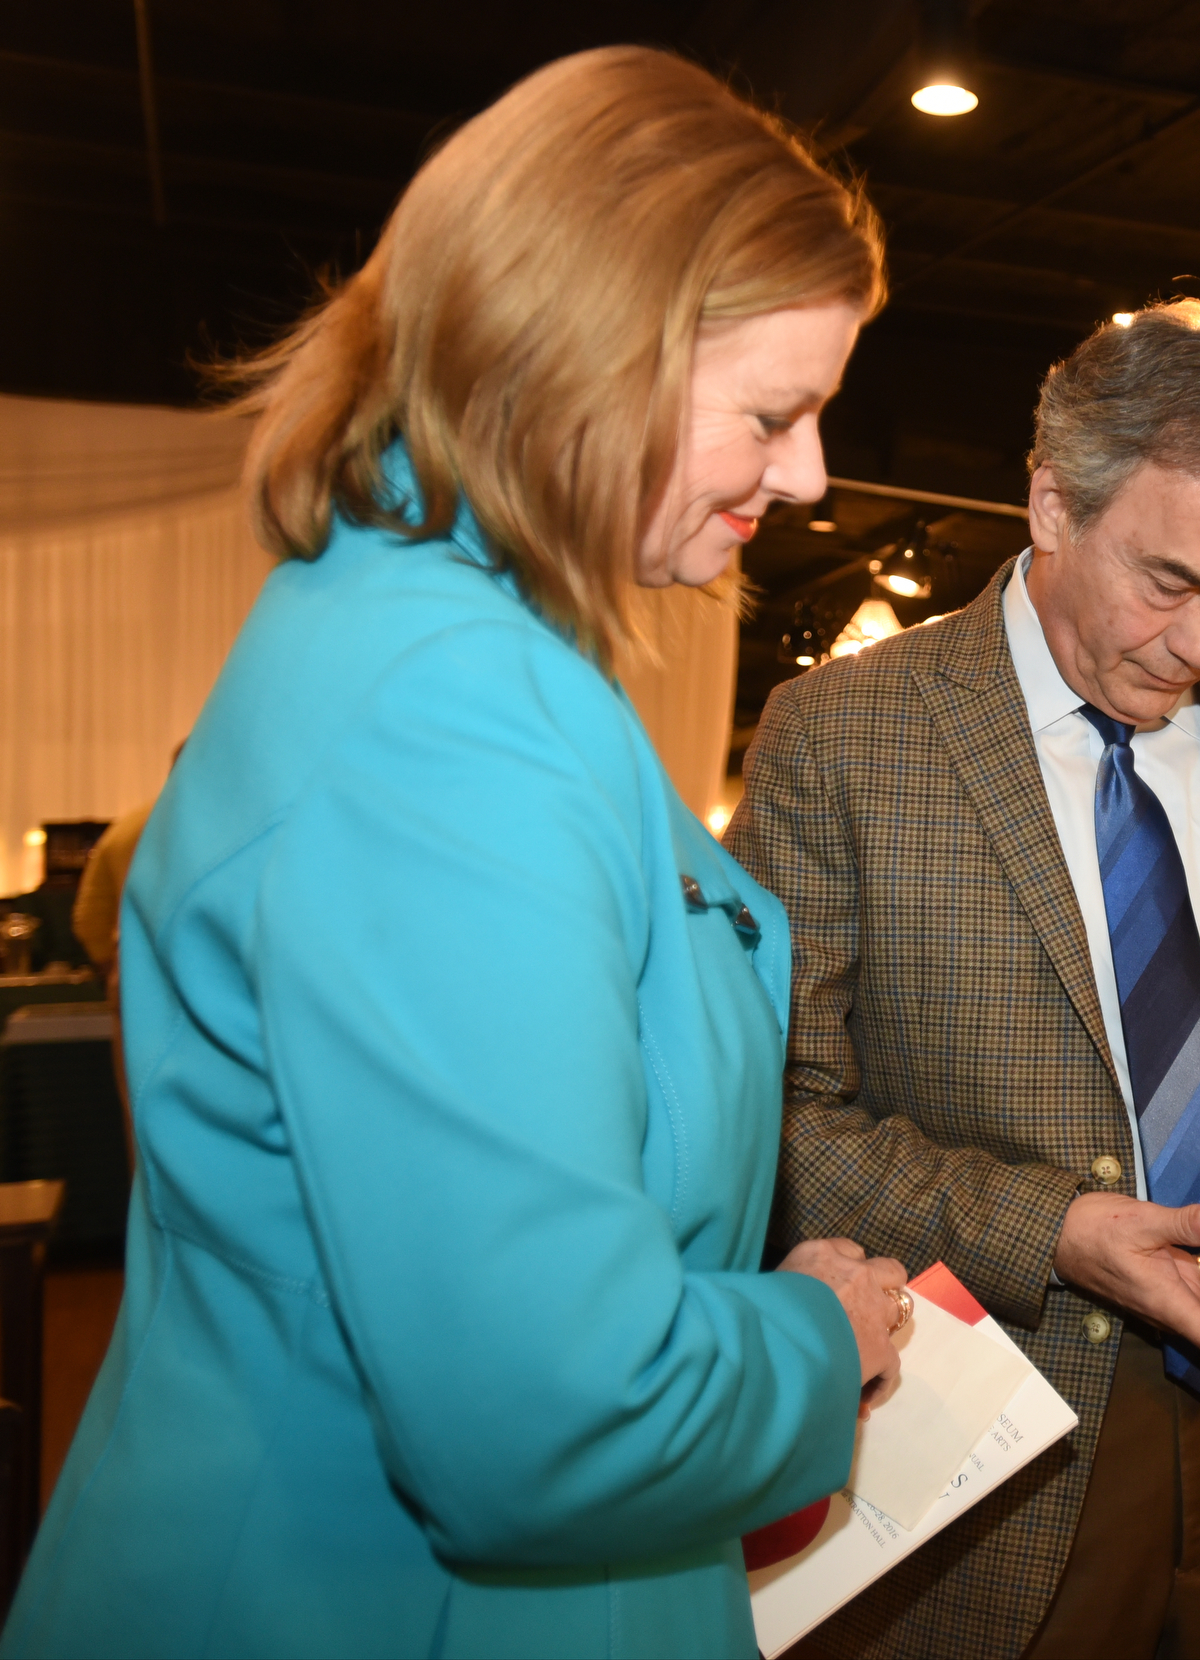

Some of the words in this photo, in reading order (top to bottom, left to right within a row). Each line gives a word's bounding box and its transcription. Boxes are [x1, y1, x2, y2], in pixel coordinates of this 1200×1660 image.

[997, 1412, 1024, 1443] SEUM
[990, 1431, 1012, 1452] ARTS
[846, 1496, 874, 1531] STRATTON
[870, 1528, 886, 1549] HALL
[882, 1521, 899, 1540] 2016
